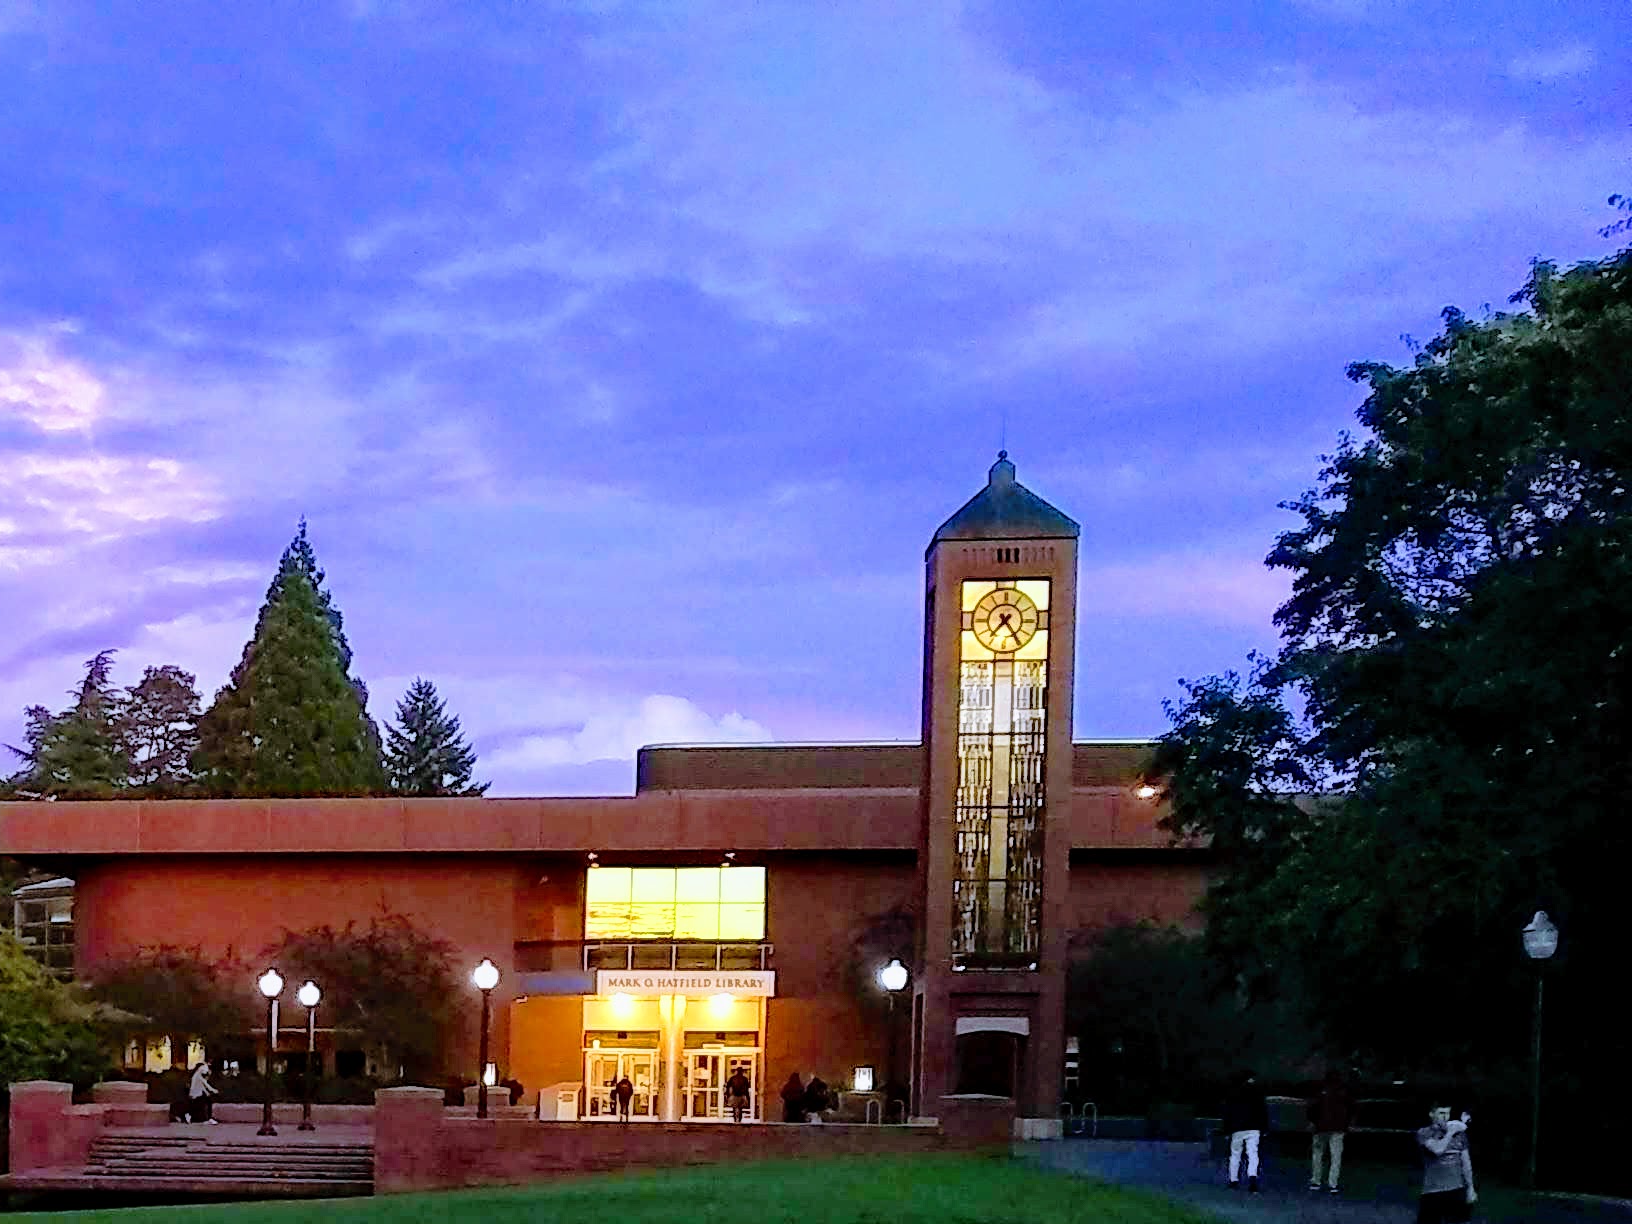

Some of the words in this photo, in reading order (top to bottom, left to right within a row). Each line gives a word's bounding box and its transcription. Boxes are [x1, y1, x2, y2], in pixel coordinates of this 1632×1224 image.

[608, 978, 641, 988] MARK
[657, 978, 712, 988] HATFIELD
[716, 978, 764, 988] LIBRARY
